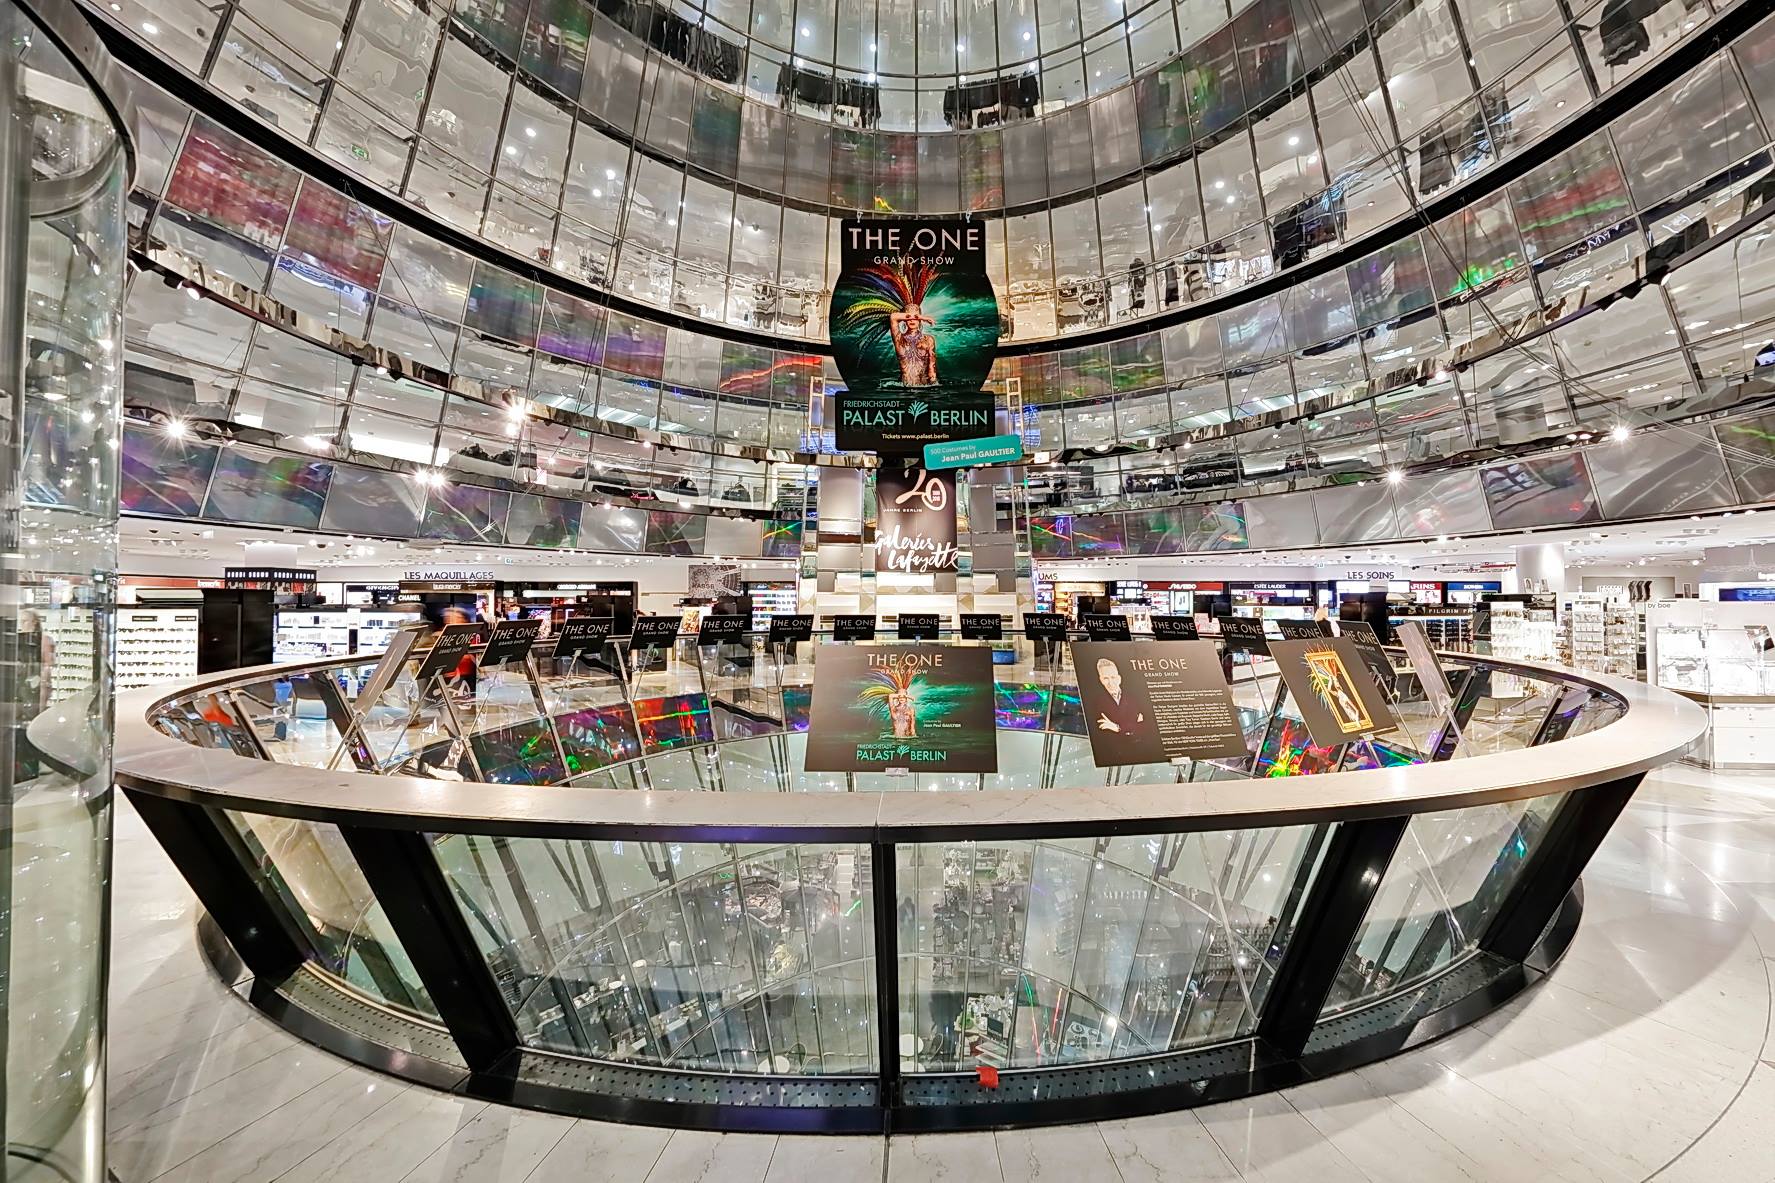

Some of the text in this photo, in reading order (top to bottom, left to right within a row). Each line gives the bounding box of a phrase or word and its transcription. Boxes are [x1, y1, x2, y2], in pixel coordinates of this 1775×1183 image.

[848, 228, 979, 250] THE ONE
[874, 256, 955, 265] GRAND SHOW
[843, 410, 988, 426] PALAST BERLIN
[942, 447, 1015, 462] Jean Paul GAULTIER
[895, 469, 947, 511] 20
[888, 542, 959, 572] Lafayette
[404, 572, 494, 580] LES MAQUILLAGES
[1347, 571, 1394, 580] LES SOINS
[637, 622, 679, 631] THE ONE
[723, 620, 744, 628] ONE
[772, 619, 812, 627] THE ONE
[1025, 617, 1064, 626] THE ONE
[1087, 619, 1127, 628] THE ONE
[1154, 621, 1196, 631] THE ONE
[494, 627, 538, 640] THE ONE
[565, 624, 610, 634] THE ONE
[1221, 622, 1263, 635] THE ONE
[1280, 626, 1320, 637] THE ONE
[437, 632, 476, 647] THE ONE
[867, 654, 943, 666] THE ONE
[1130, 658, 1188, 670] THE ONE
[857, 750, 946, 760] PALAST BERLIN
